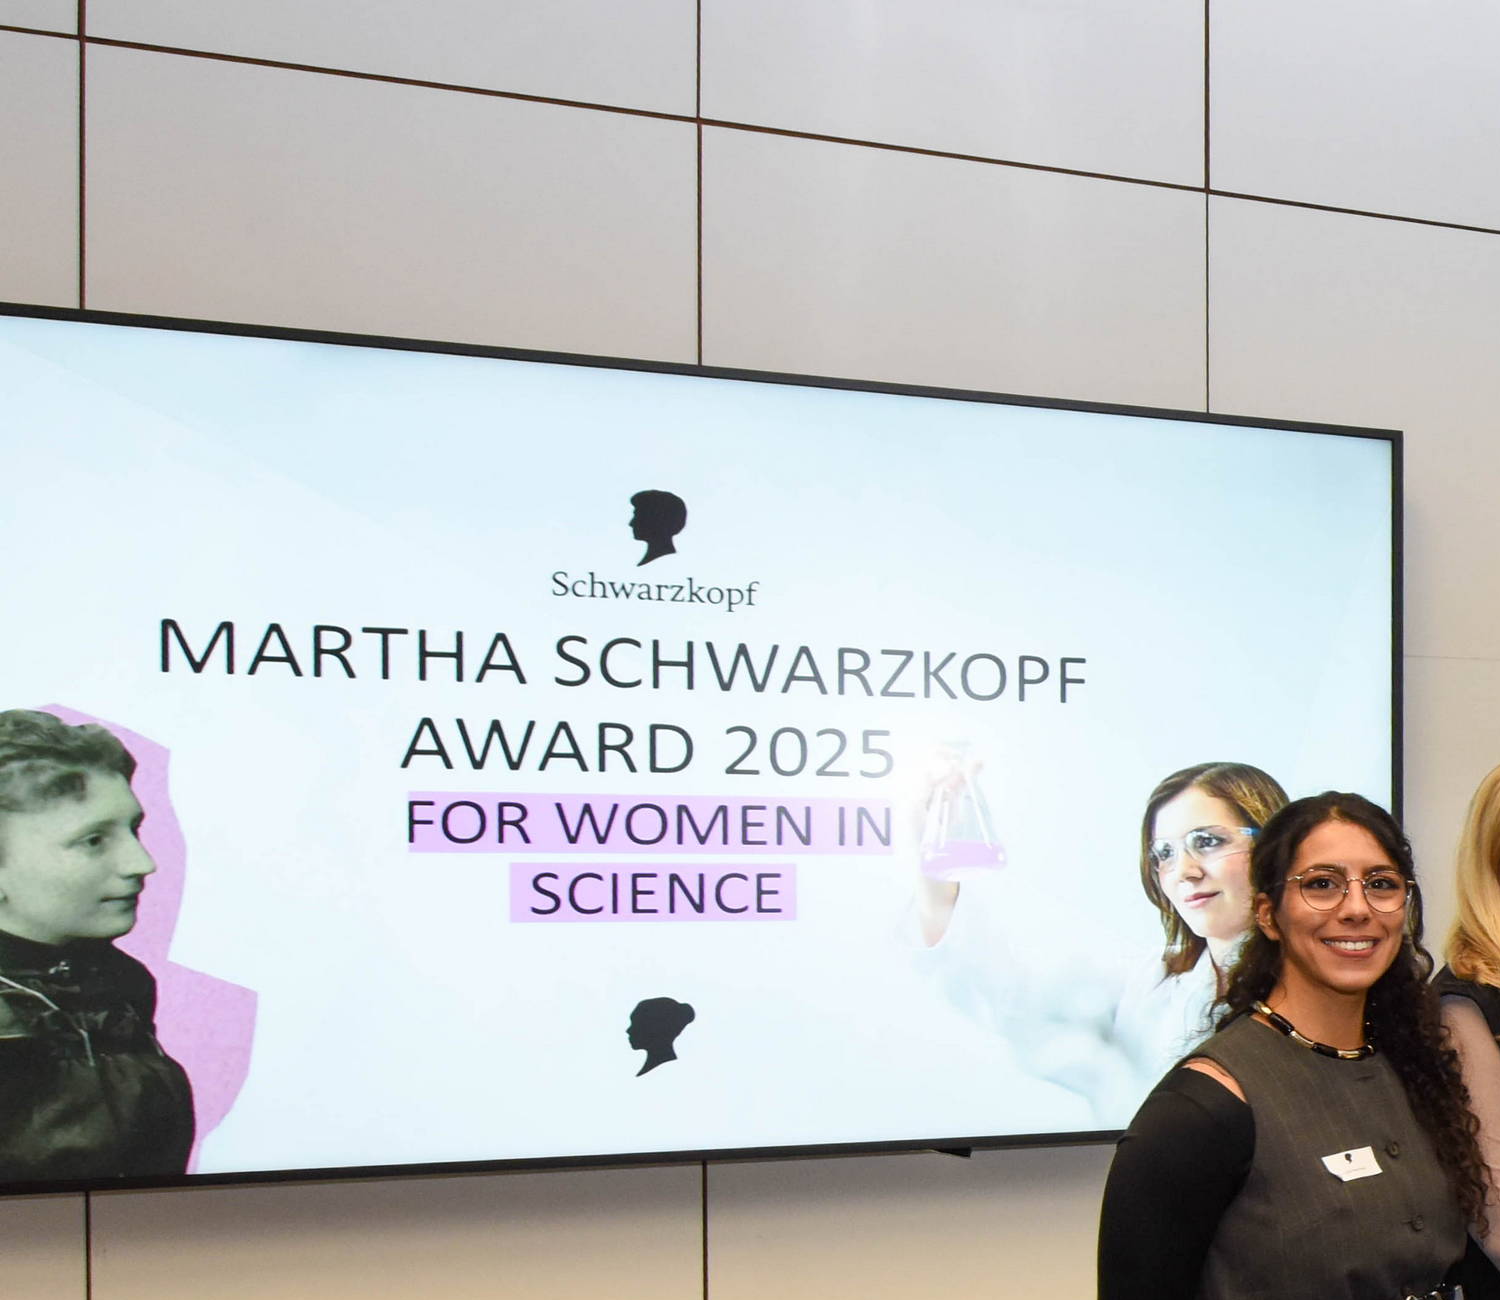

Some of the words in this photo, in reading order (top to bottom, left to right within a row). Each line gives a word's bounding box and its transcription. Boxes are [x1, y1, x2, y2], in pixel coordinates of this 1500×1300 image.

[551, 570, 761, 613] Schwarzkopf
[159, 617, 528, 685] MARTHA
[553, 634, 1087, 704] SCHWARZKOPF
[399, 716, 694, 774] AWARD
[724, 725, 894, 779] 2025
[407, 799, 532, 845] FOR
[553, 801, 812, 847] WOMEN
[838, 806, 893, 847] IN
[529, 871, 783, 915] SCIENCE
